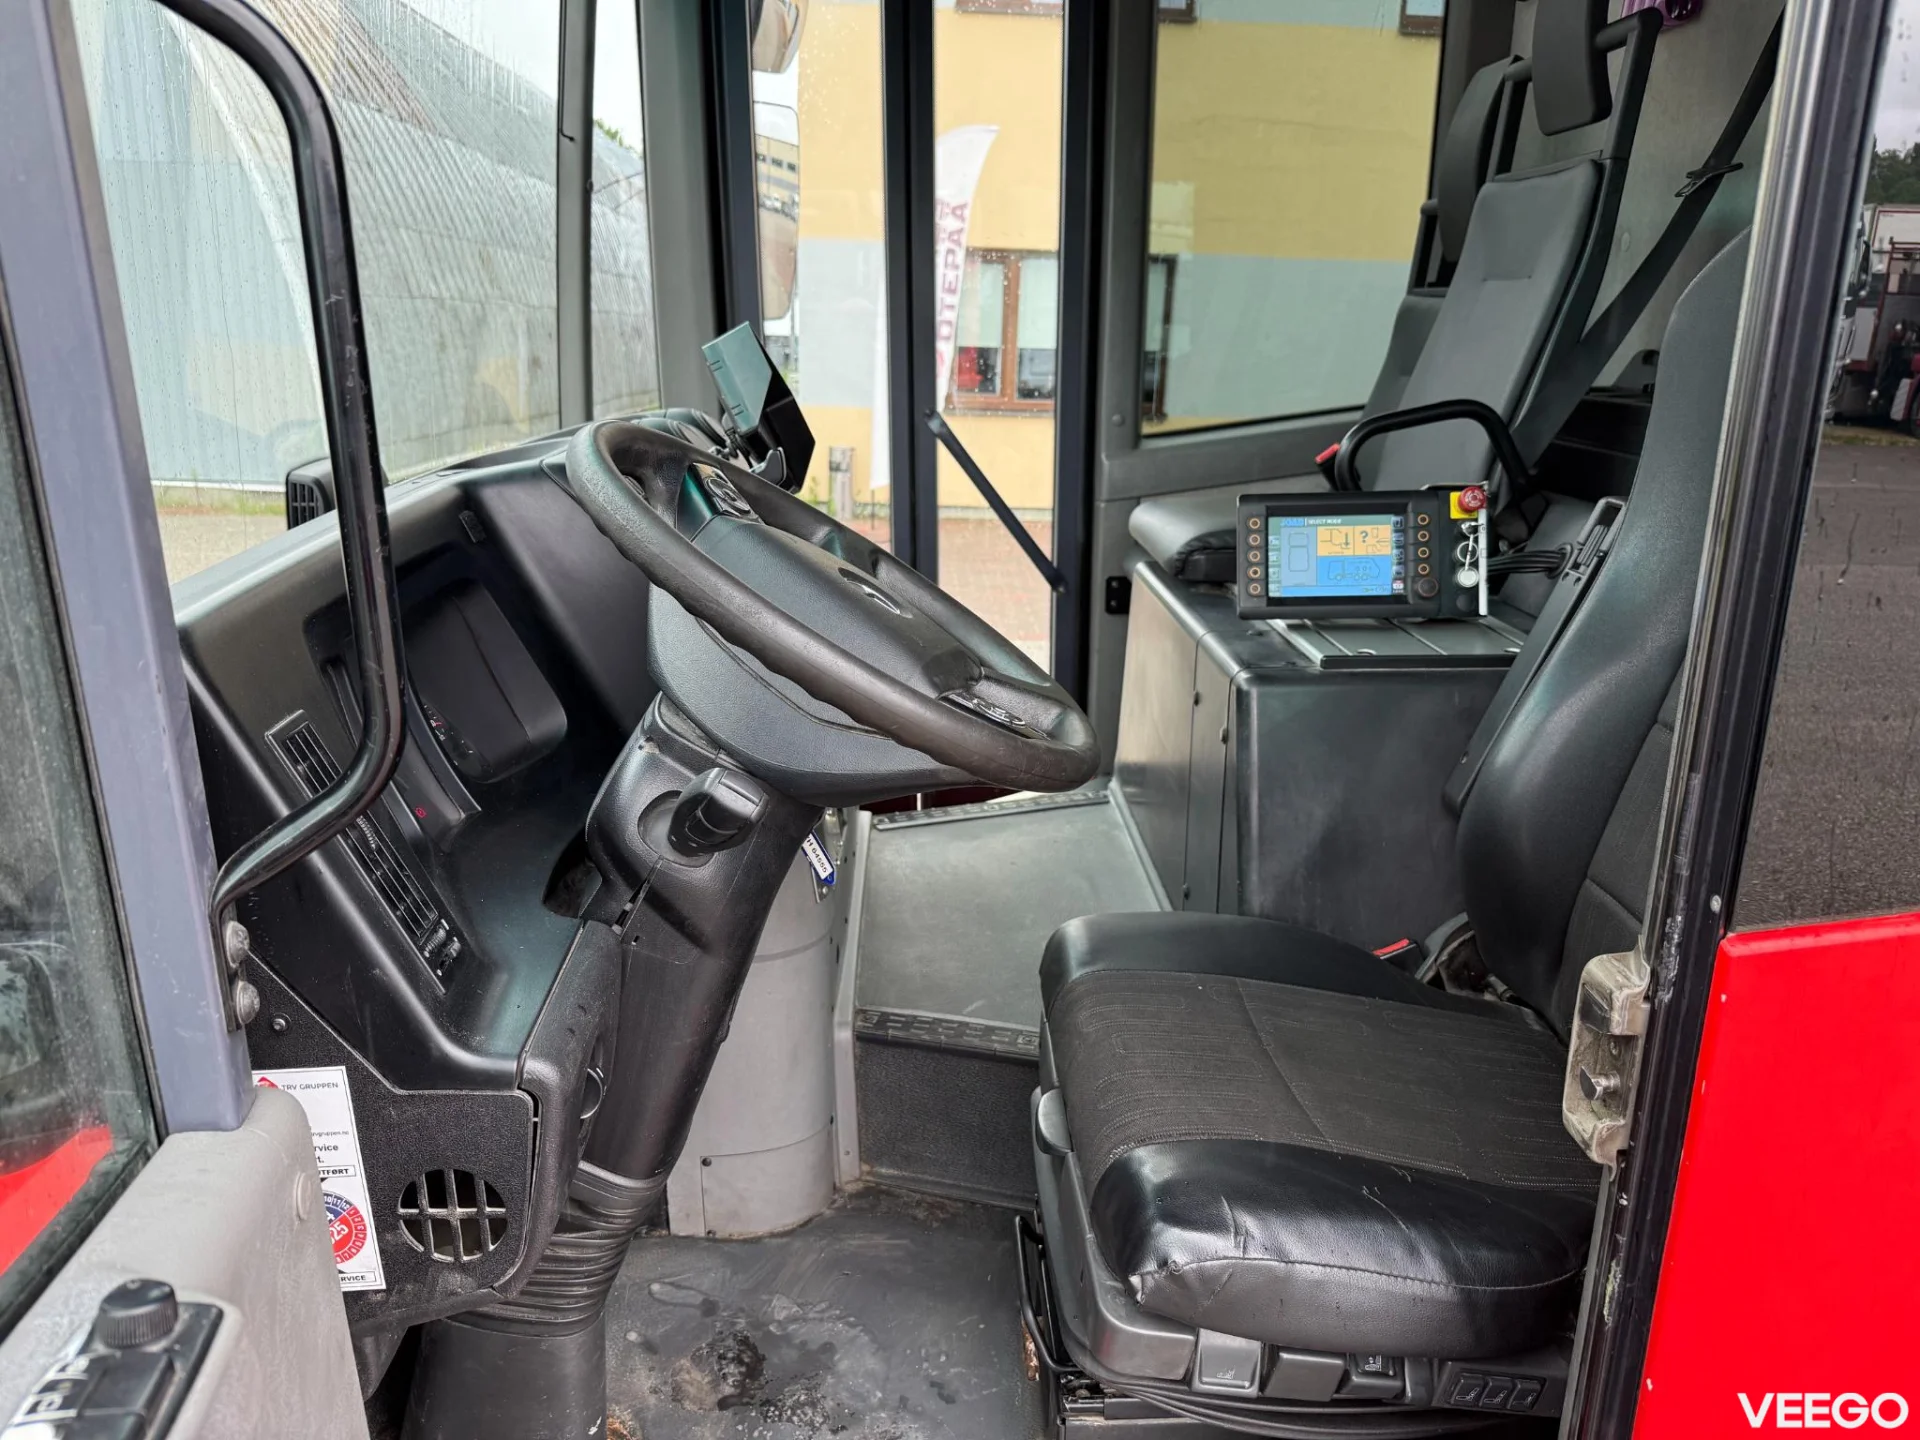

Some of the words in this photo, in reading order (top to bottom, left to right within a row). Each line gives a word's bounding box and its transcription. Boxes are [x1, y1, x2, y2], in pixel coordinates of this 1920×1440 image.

[299, 1082, 339, 1090] GRUPPEN
[314, 1143, 339, 1152] rvice
[329, 1221, 349, 1245] 25
